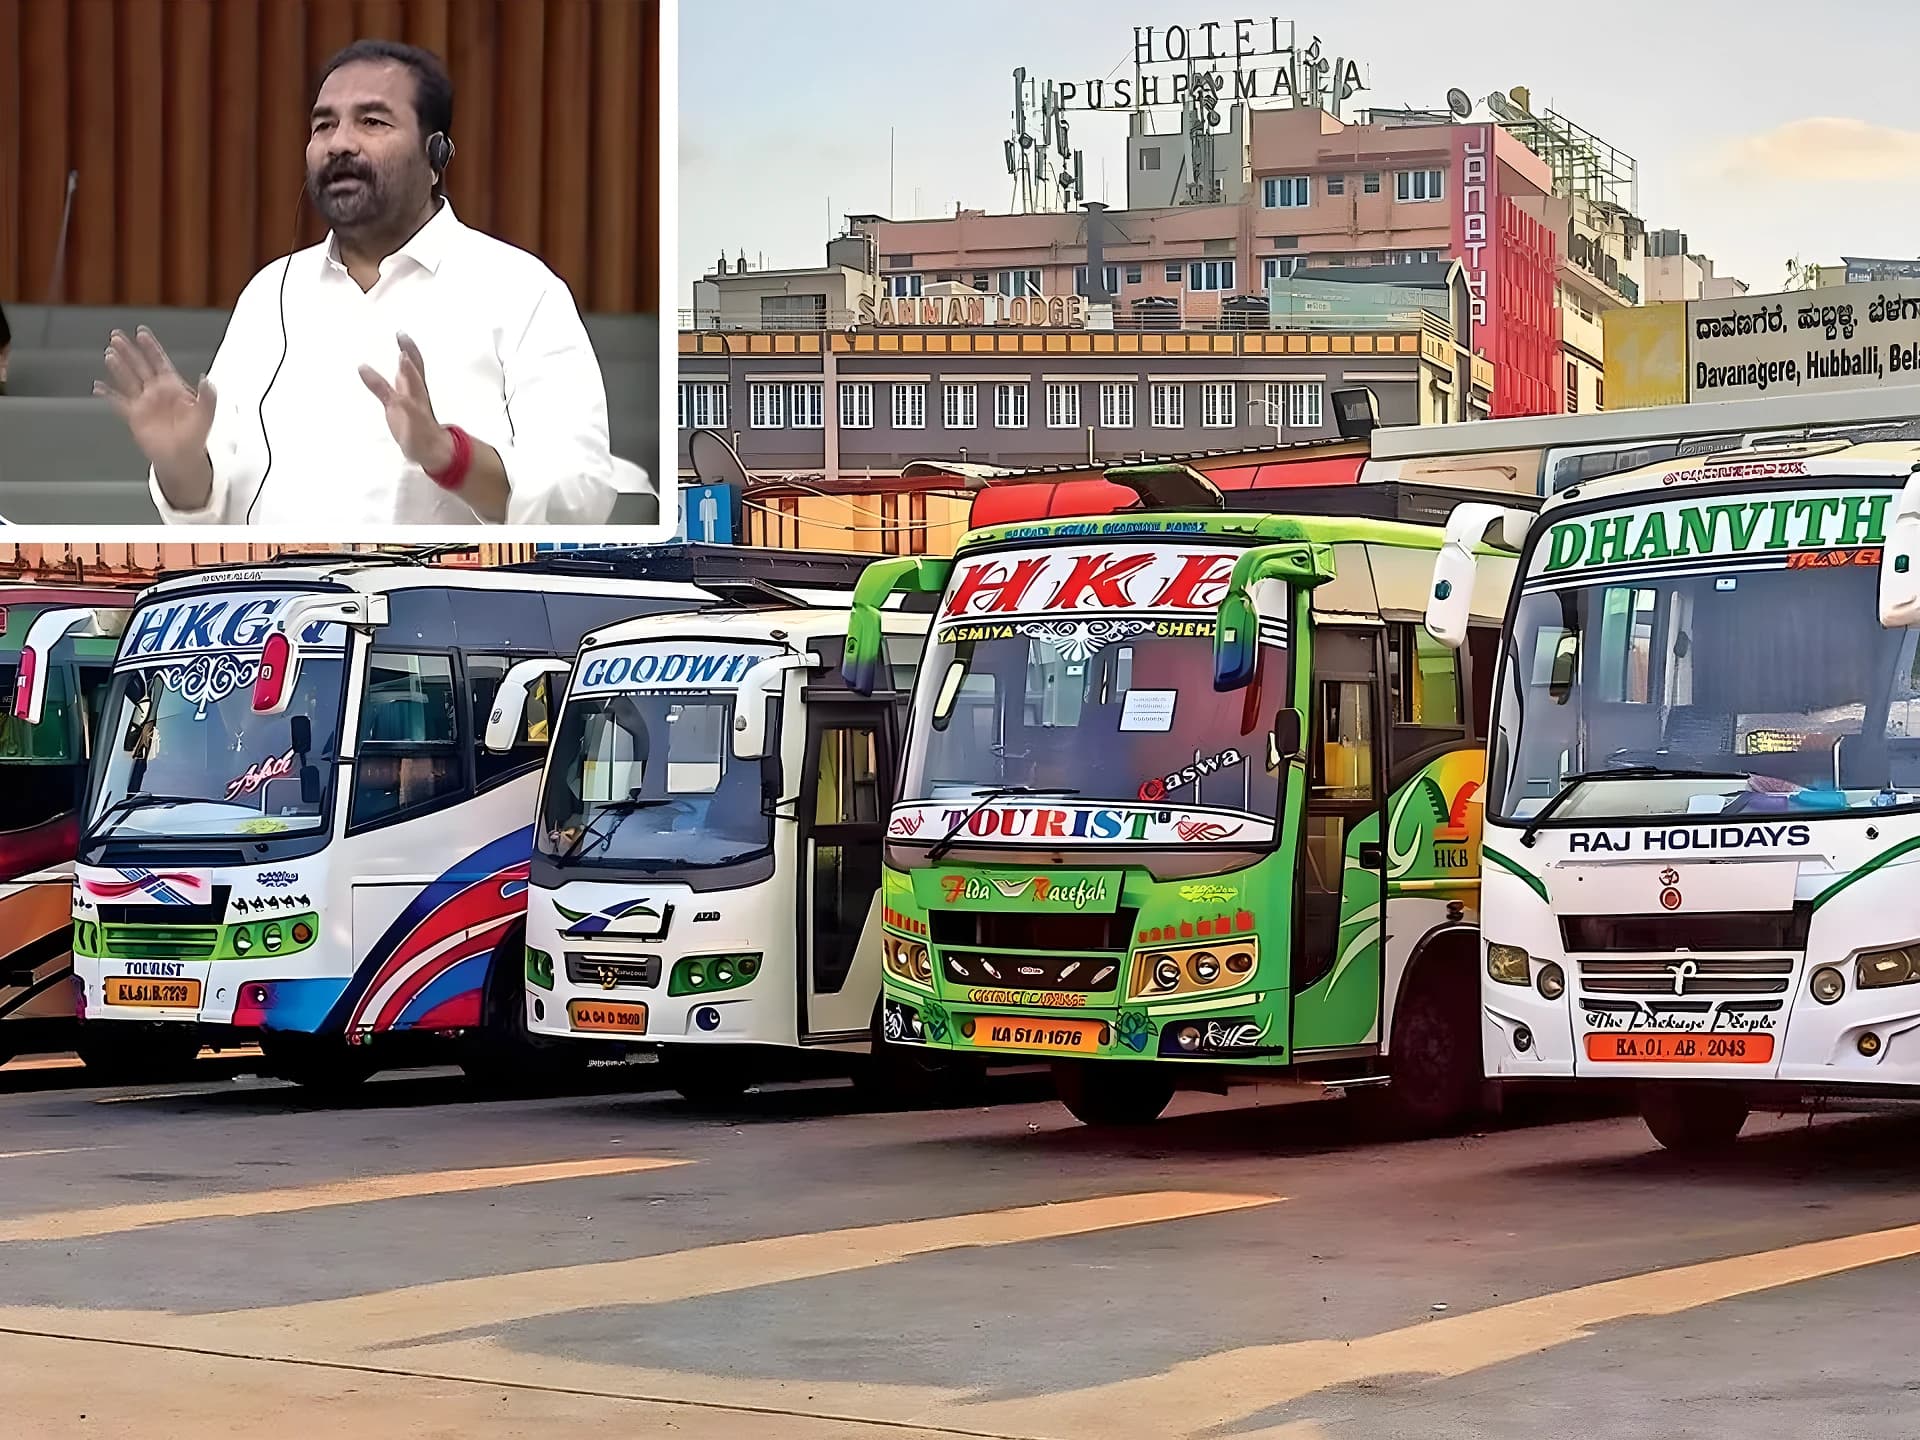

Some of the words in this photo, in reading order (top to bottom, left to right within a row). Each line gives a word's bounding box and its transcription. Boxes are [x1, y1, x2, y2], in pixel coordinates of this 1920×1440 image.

[1133, 16, 1293, 63] HOTEL
[1059, 59, 1366, 109] PUSHPMAA
[1463, 127, 1487, 326] JANATHA
[995, 295, 1086, 328] LODGE
[1696, 360, 1800, 391] Davanagere,
[1806, 346, 1883, 380] Hubballi,
[1543, 494, 1893, 572] DHANVITH
[940, 807, 1158, 841] TOURIST
[1569, 831, 1631, 853] RAJ
[1643, 824, 1811, 851] HOLIDAYS
[1433, 848, 1468, 868] HKB
